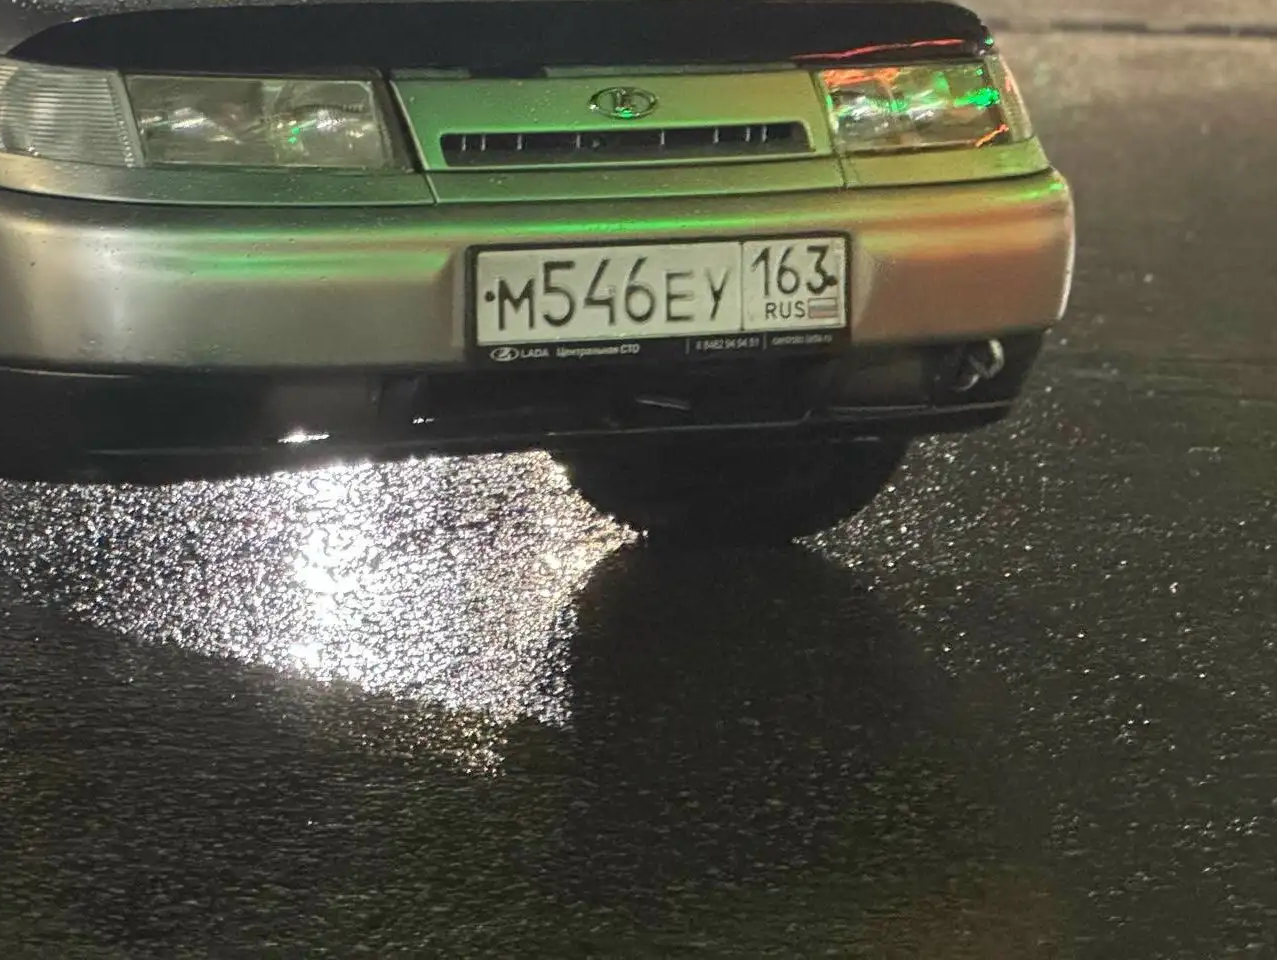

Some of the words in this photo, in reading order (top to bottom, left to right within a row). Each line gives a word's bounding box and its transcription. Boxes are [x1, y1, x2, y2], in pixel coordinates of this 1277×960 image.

[749, 244, 830, 297] 163
[764, 300, 807, 320] RUS
[520, 347, 550, 358] LADA
